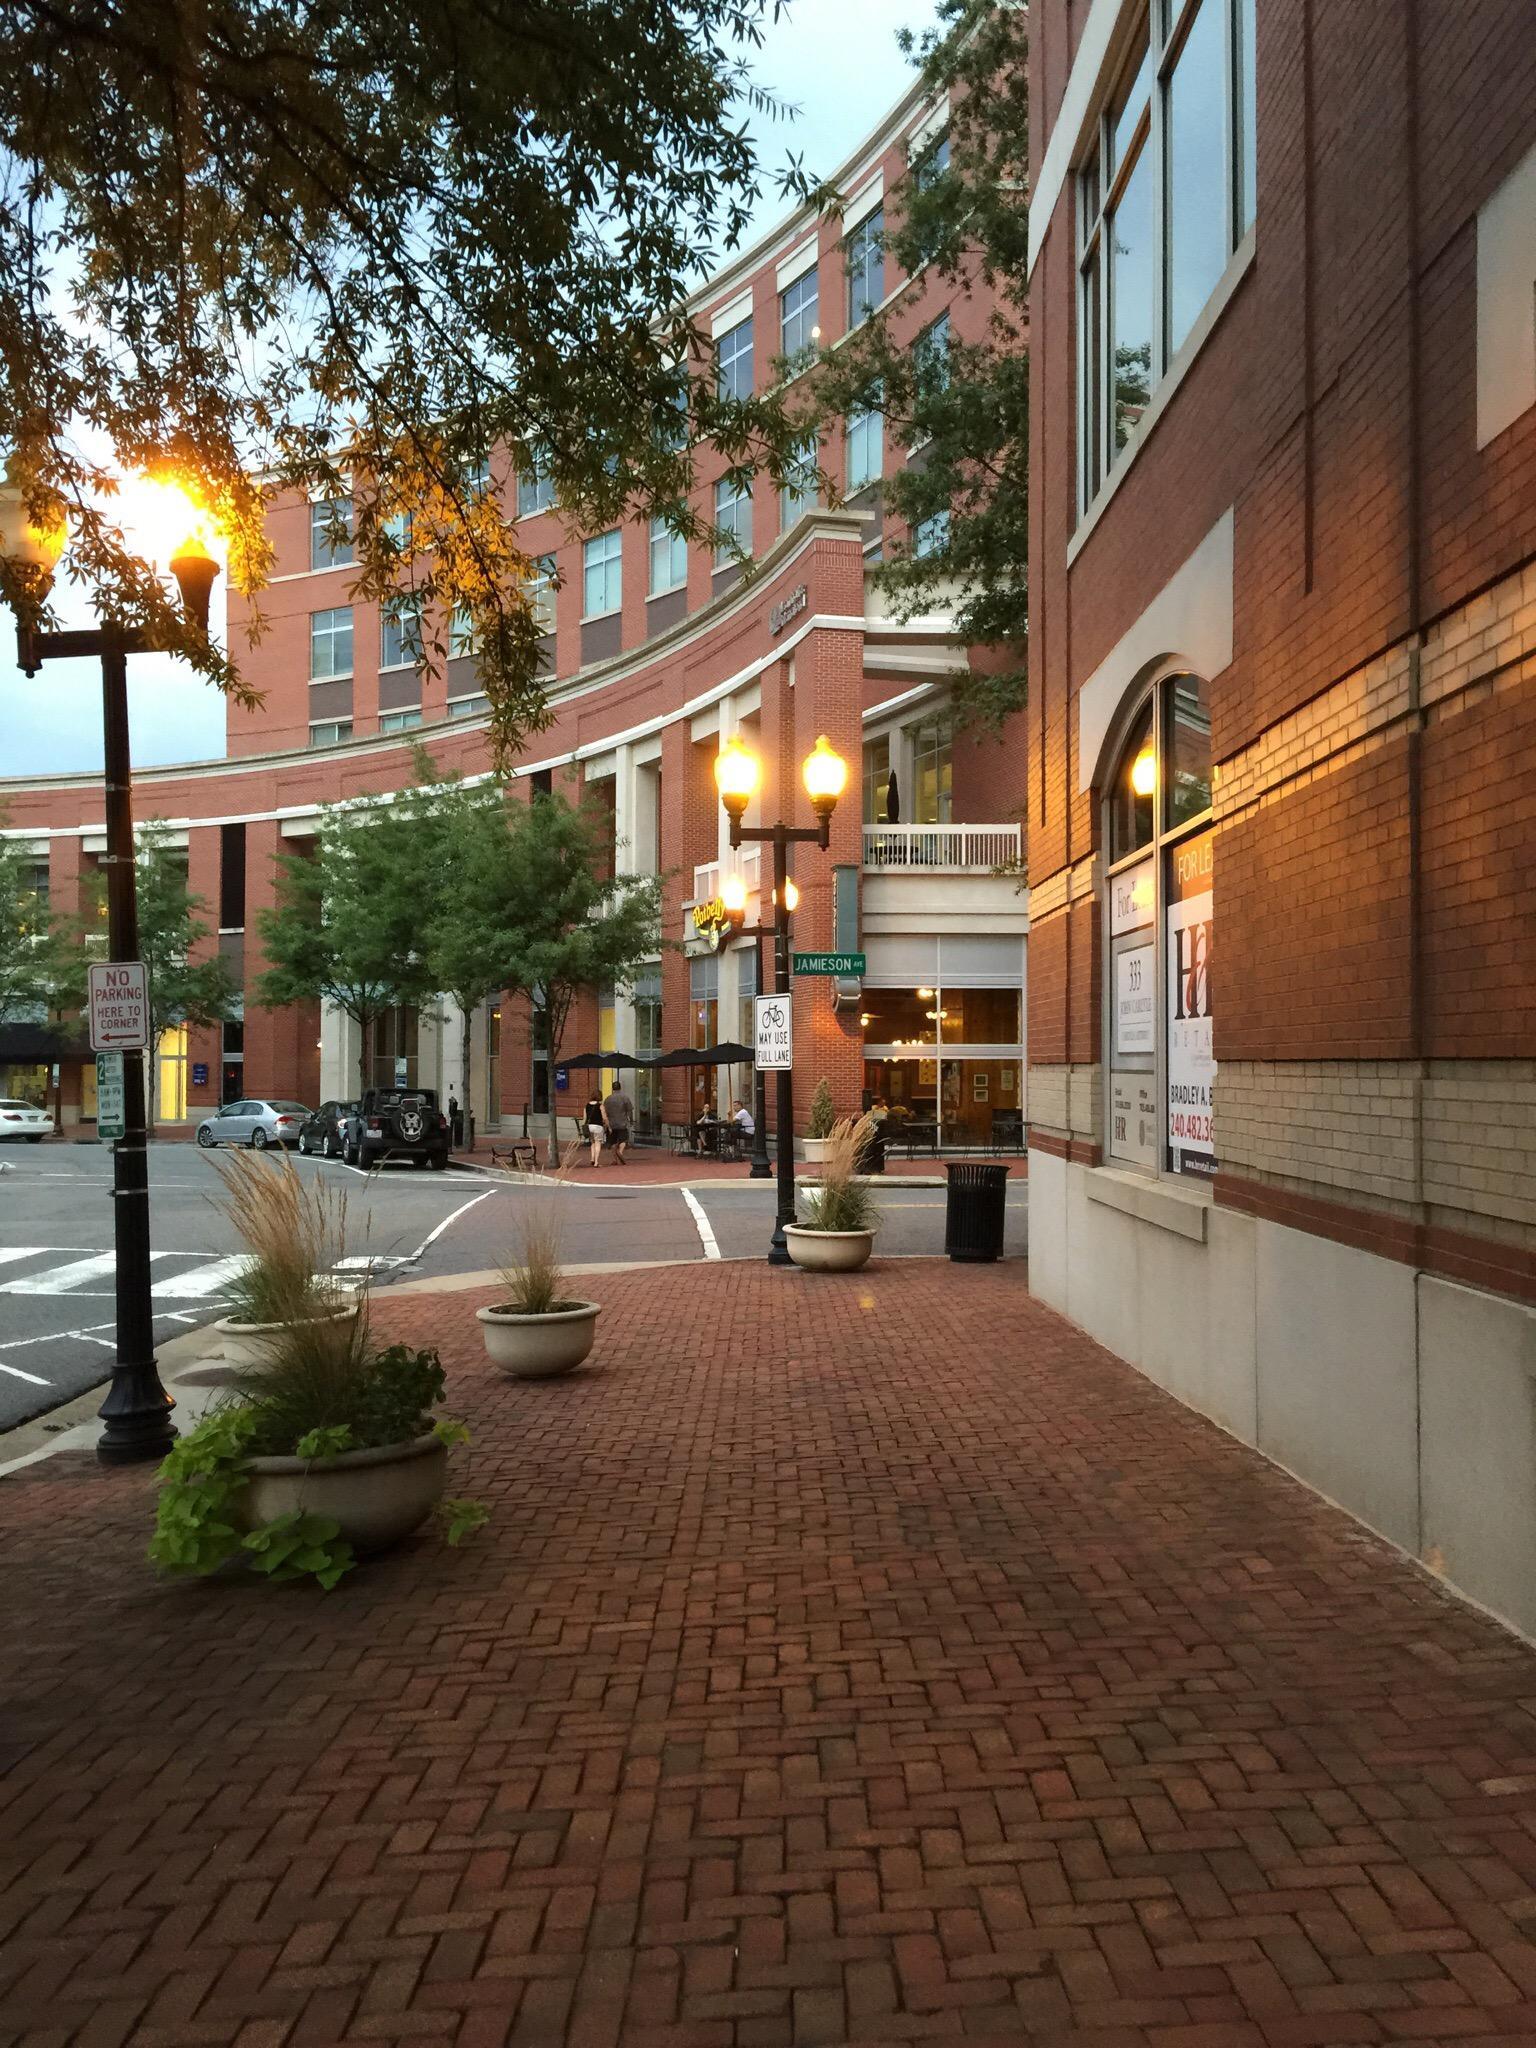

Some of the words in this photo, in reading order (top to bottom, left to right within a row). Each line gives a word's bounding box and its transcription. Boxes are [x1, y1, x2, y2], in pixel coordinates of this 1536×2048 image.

[1178, 850, 1198, 885] FOR
[1200, 842, 1214, 875] LE
[1117, 887, 1130, 918] For
[693, 897, 726, 928] Potbelly
[795, 958, 852, 971] JAMIESON
[106, 970, 130, 987] NO
[1129, 960, 1142, 992] 333
[95, 987, 142, 1002] PARKING
[97, 1006, 124, 1018] HERE
[128, 1005, 141, 1016] TO
[100, 1018, 139, 1030] CORNER
[758, 1032, 772, 1045] MAY
[774, 1031, 788, 1044] USE
[758, 1050, 772, 1062] FULL
[774, 1049, 789, 1062] LANE
[98, 1060, 105, 1081] 2
[1170, 1085, 1200, 1105] BRADLEY
[1201, 1086, 1208, 1106] A.
